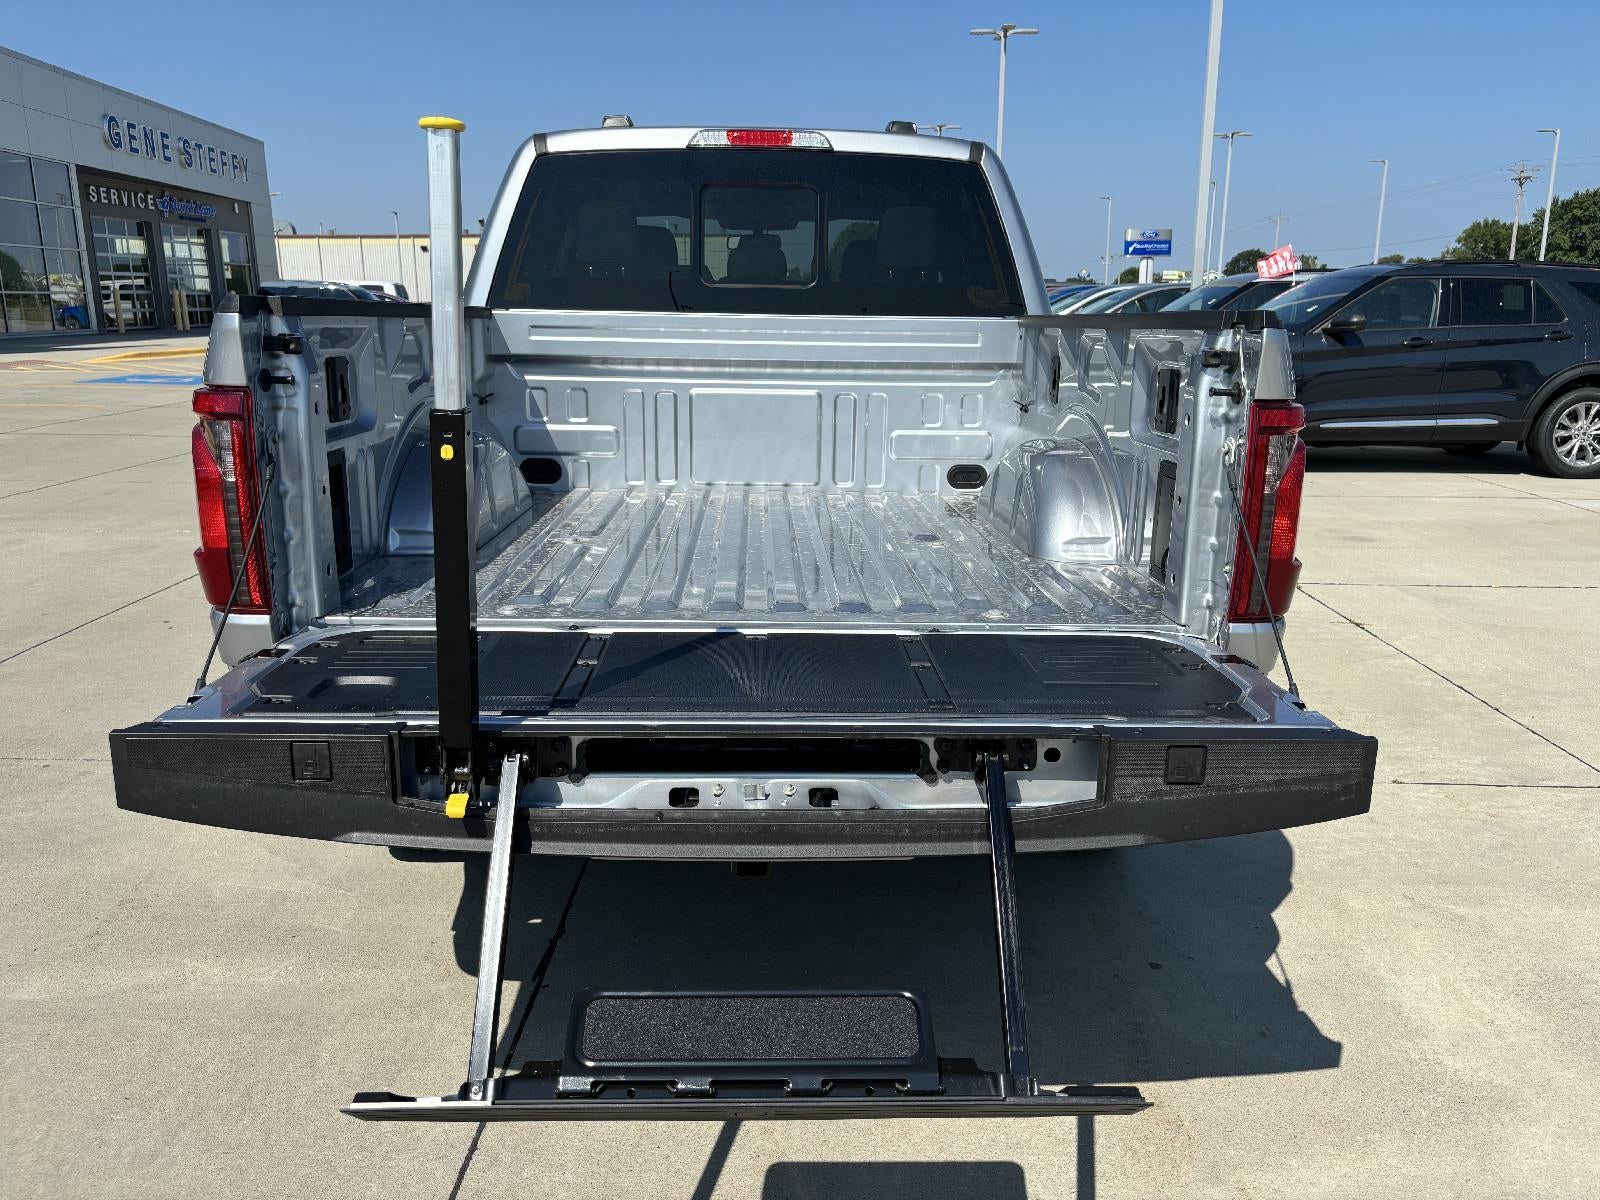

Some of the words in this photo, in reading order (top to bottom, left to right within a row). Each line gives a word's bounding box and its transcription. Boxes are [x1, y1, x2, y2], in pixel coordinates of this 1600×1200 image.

[104, 113, 172, 164] GENE
[179, 136, 249, 184] STEFFY
[88, 185, 156, 211] SERVICE
[171, 196, 196, 215] Quick
[196, 201, 217, 218] Lane
